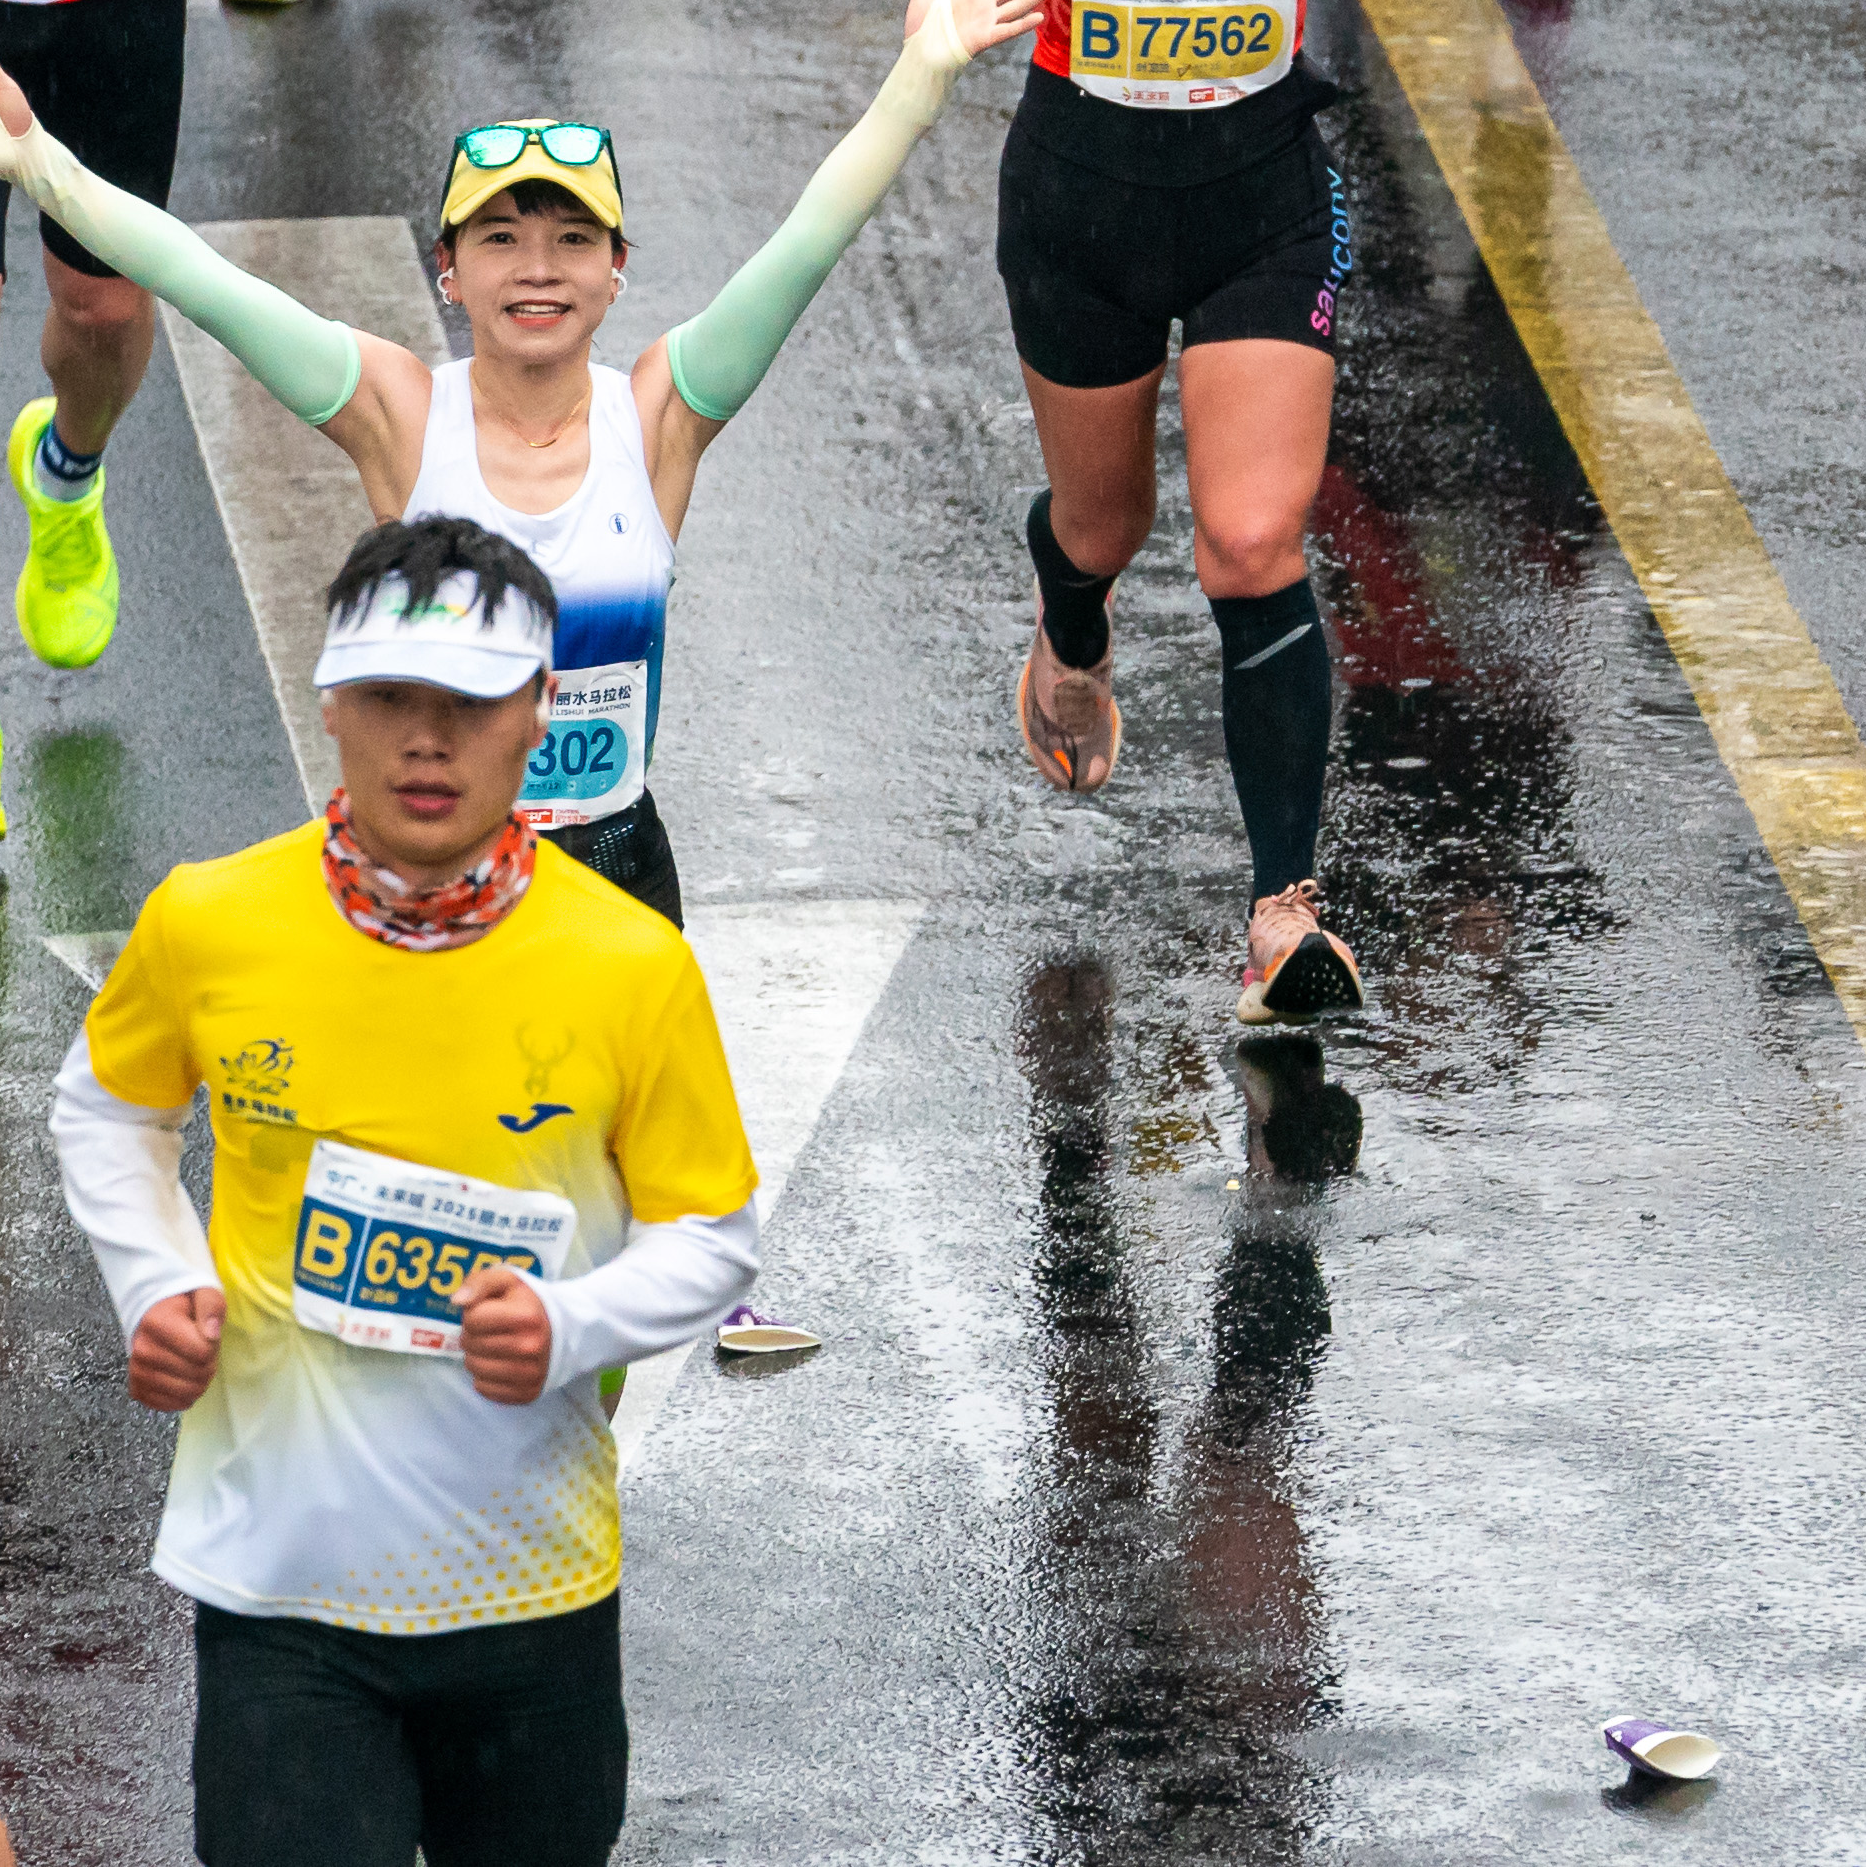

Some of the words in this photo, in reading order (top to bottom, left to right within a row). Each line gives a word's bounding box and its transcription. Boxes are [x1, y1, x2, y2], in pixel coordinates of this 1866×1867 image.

[1082, 10, 1120, 59] B
[1136, 12, 1272, 58] 77562
[556, 685, 632, 706] 丽水马拉松
[556, 708, 584, 716] LISHUI
[588, 703, 631, 715] MARATHON
[528, 727, 614, 777] 302
[300, 1208, 353, 1278] B
